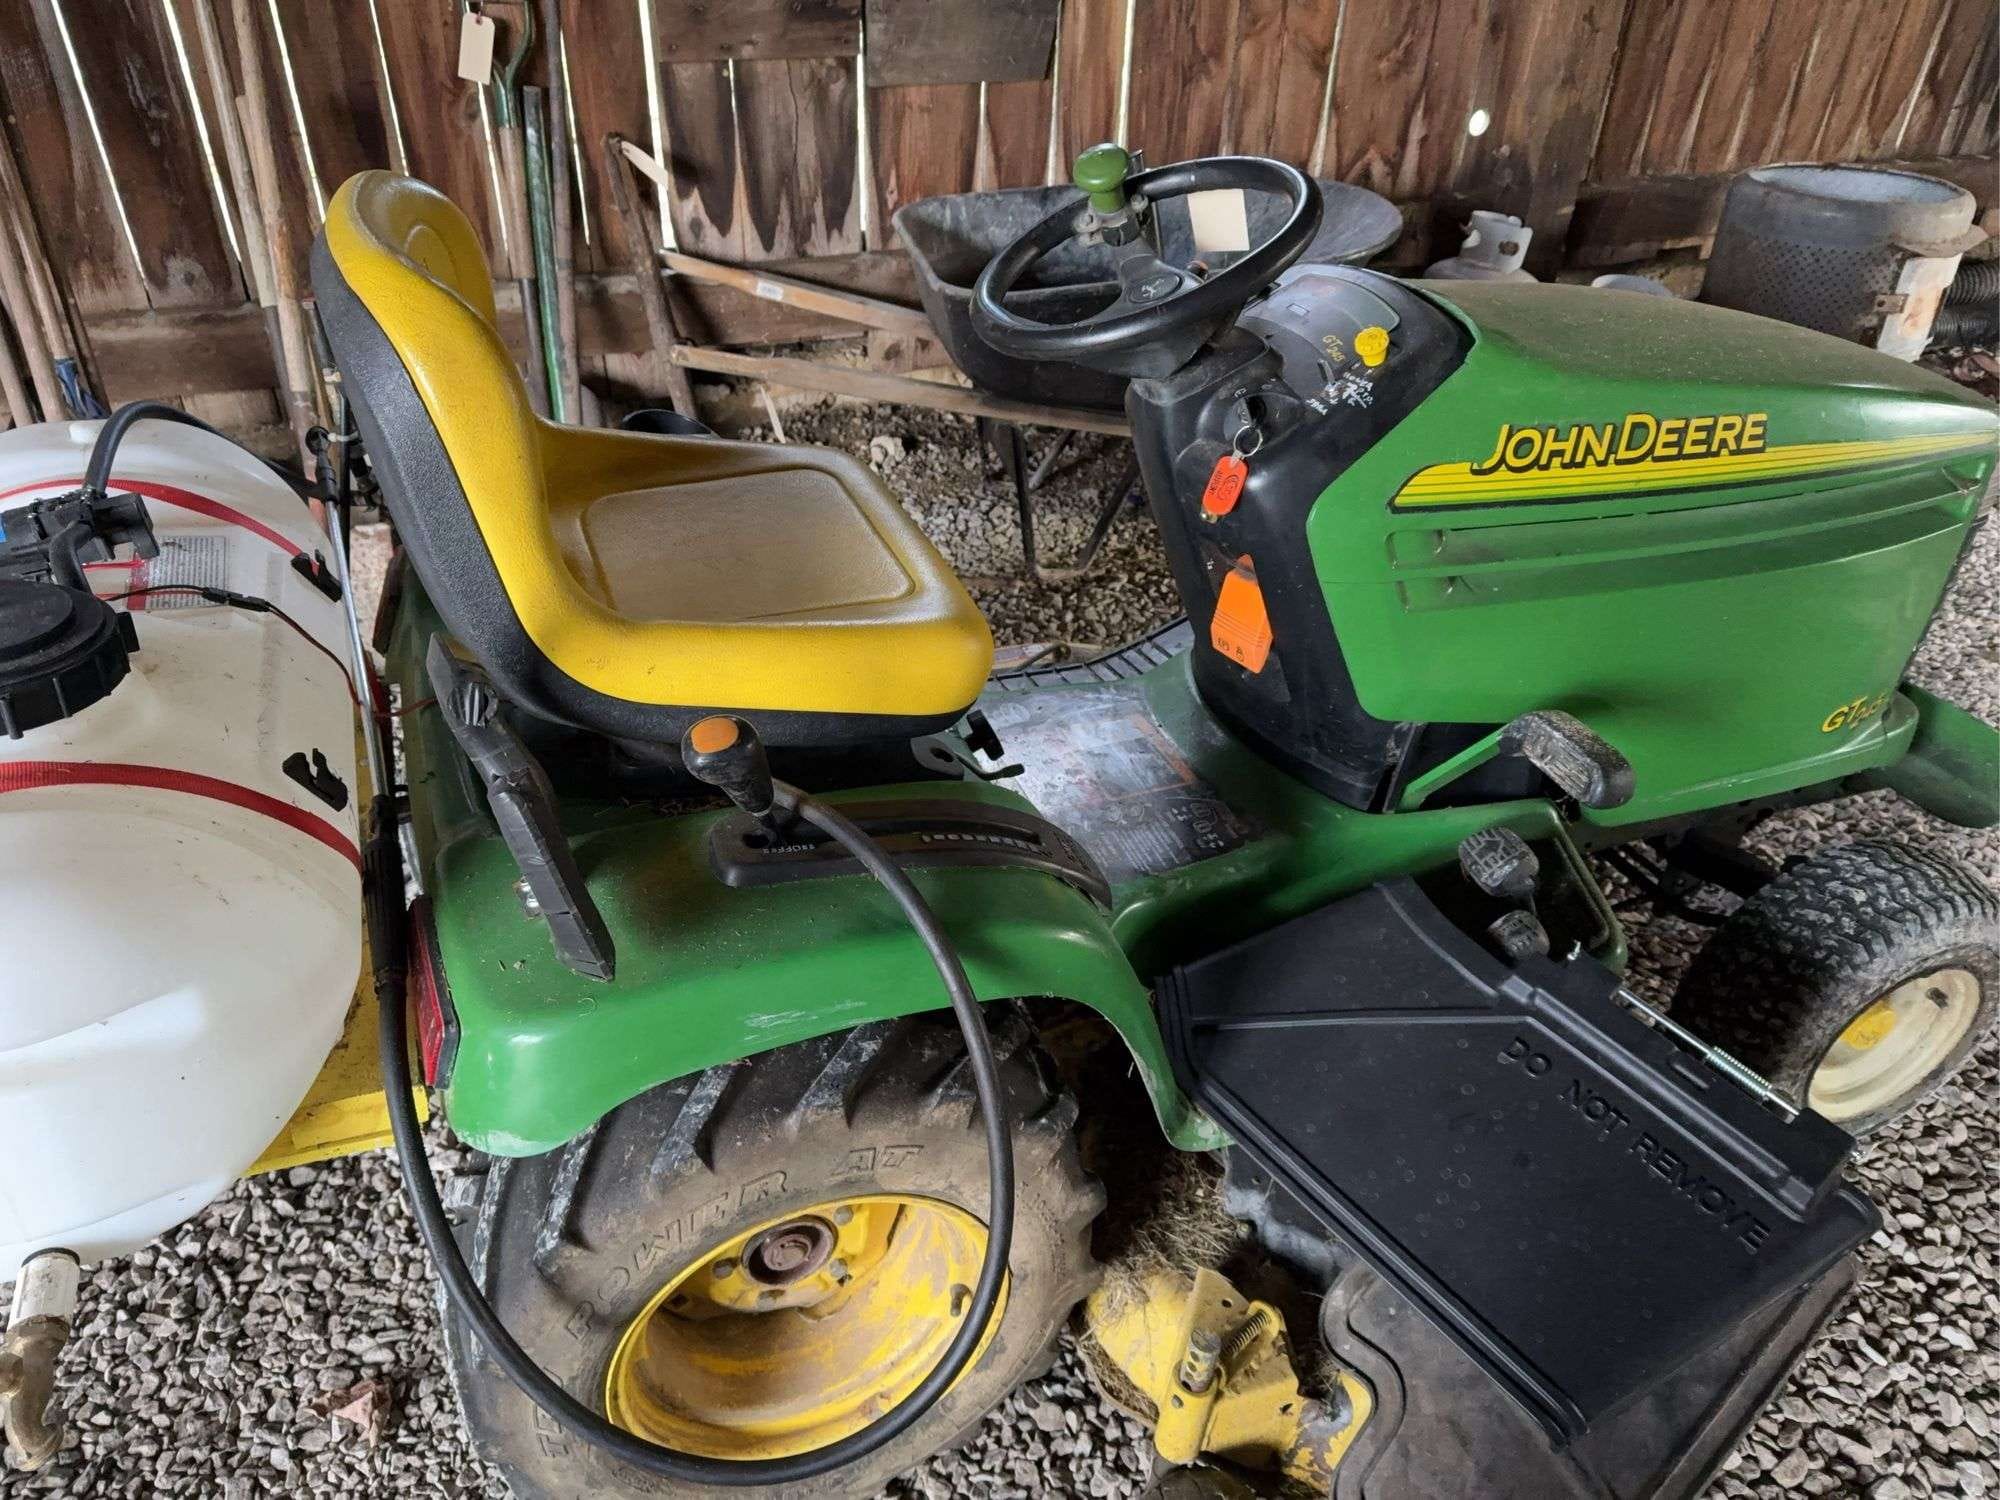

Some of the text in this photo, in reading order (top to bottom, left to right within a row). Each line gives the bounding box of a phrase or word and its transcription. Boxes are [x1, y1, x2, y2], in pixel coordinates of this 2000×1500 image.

[1470, 411, 1769, 475] JOHN DEERE
[1497, 1036, 1771, 1255] DO NOT REMOVE
[564, 1169, 788, 1342] POWER
